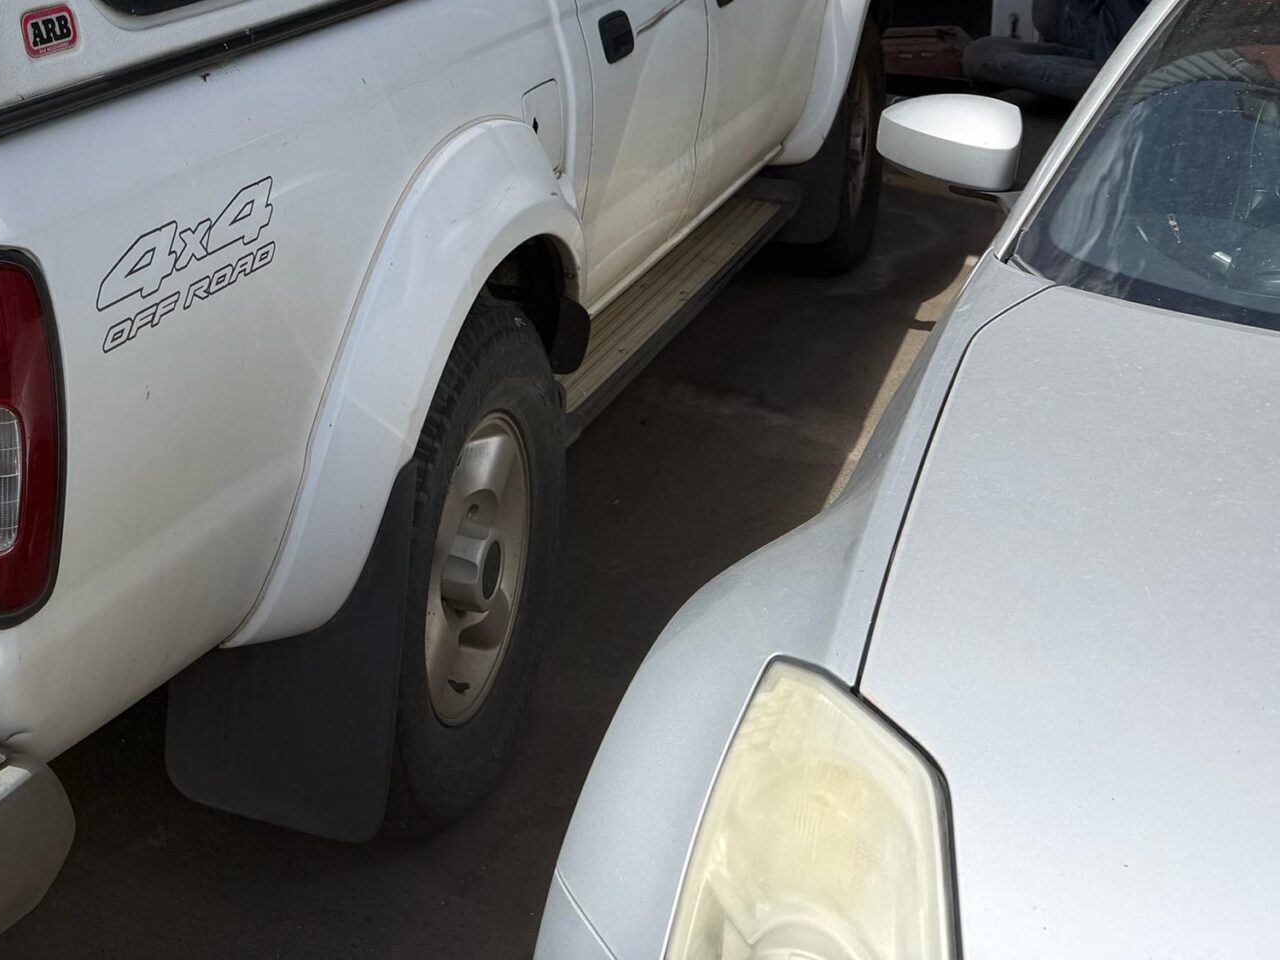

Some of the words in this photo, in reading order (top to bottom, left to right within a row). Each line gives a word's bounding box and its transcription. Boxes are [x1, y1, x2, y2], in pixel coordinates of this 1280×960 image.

[30, 14, 72, 48] ARB
[102, 290, 181, 354] OFF
[183, 241, 276, 311] ROAD
